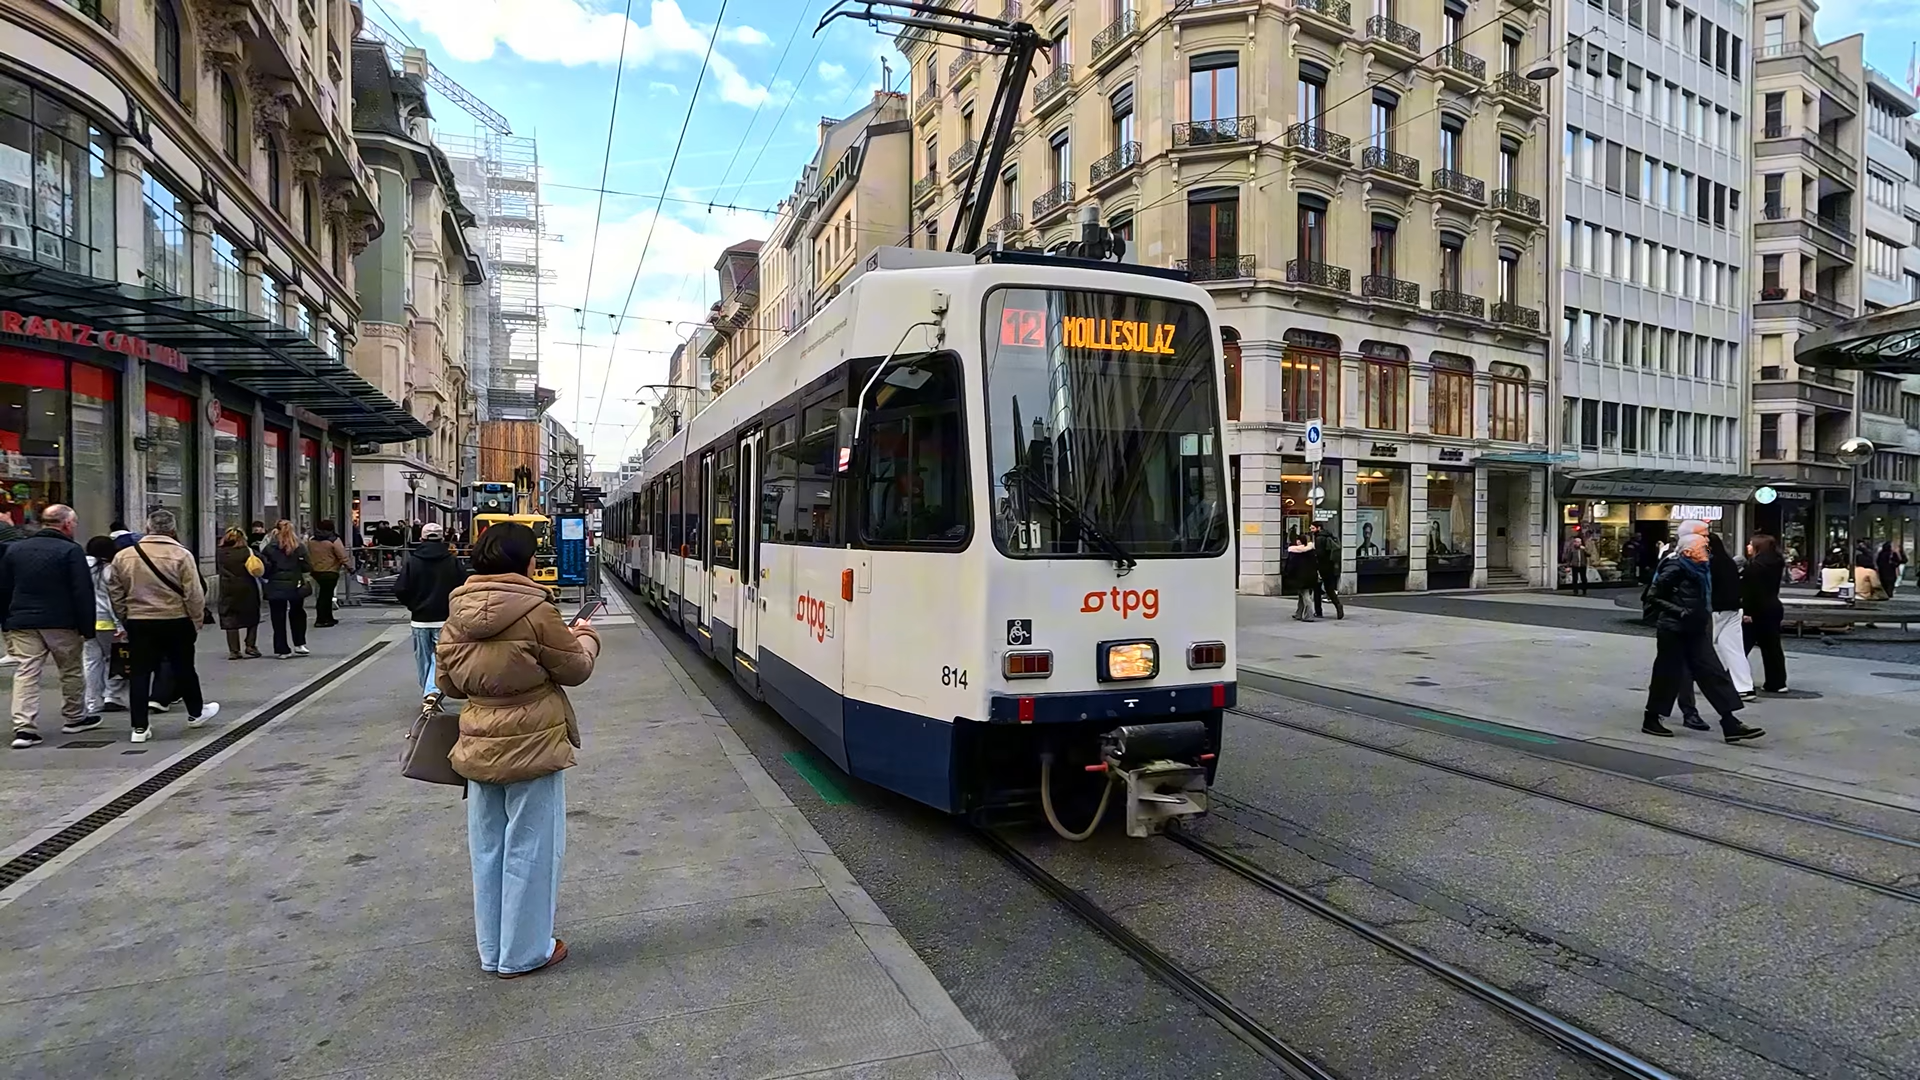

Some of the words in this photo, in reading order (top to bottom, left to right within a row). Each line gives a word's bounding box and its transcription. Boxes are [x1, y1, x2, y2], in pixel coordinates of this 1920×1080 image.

[2, 310, 94, 346] RANZ
[1004, 311, 1043, 346] 12
[1063, 315, 1176, 354] MOILLESULAZ
[941, 665, 968, 690] 814
